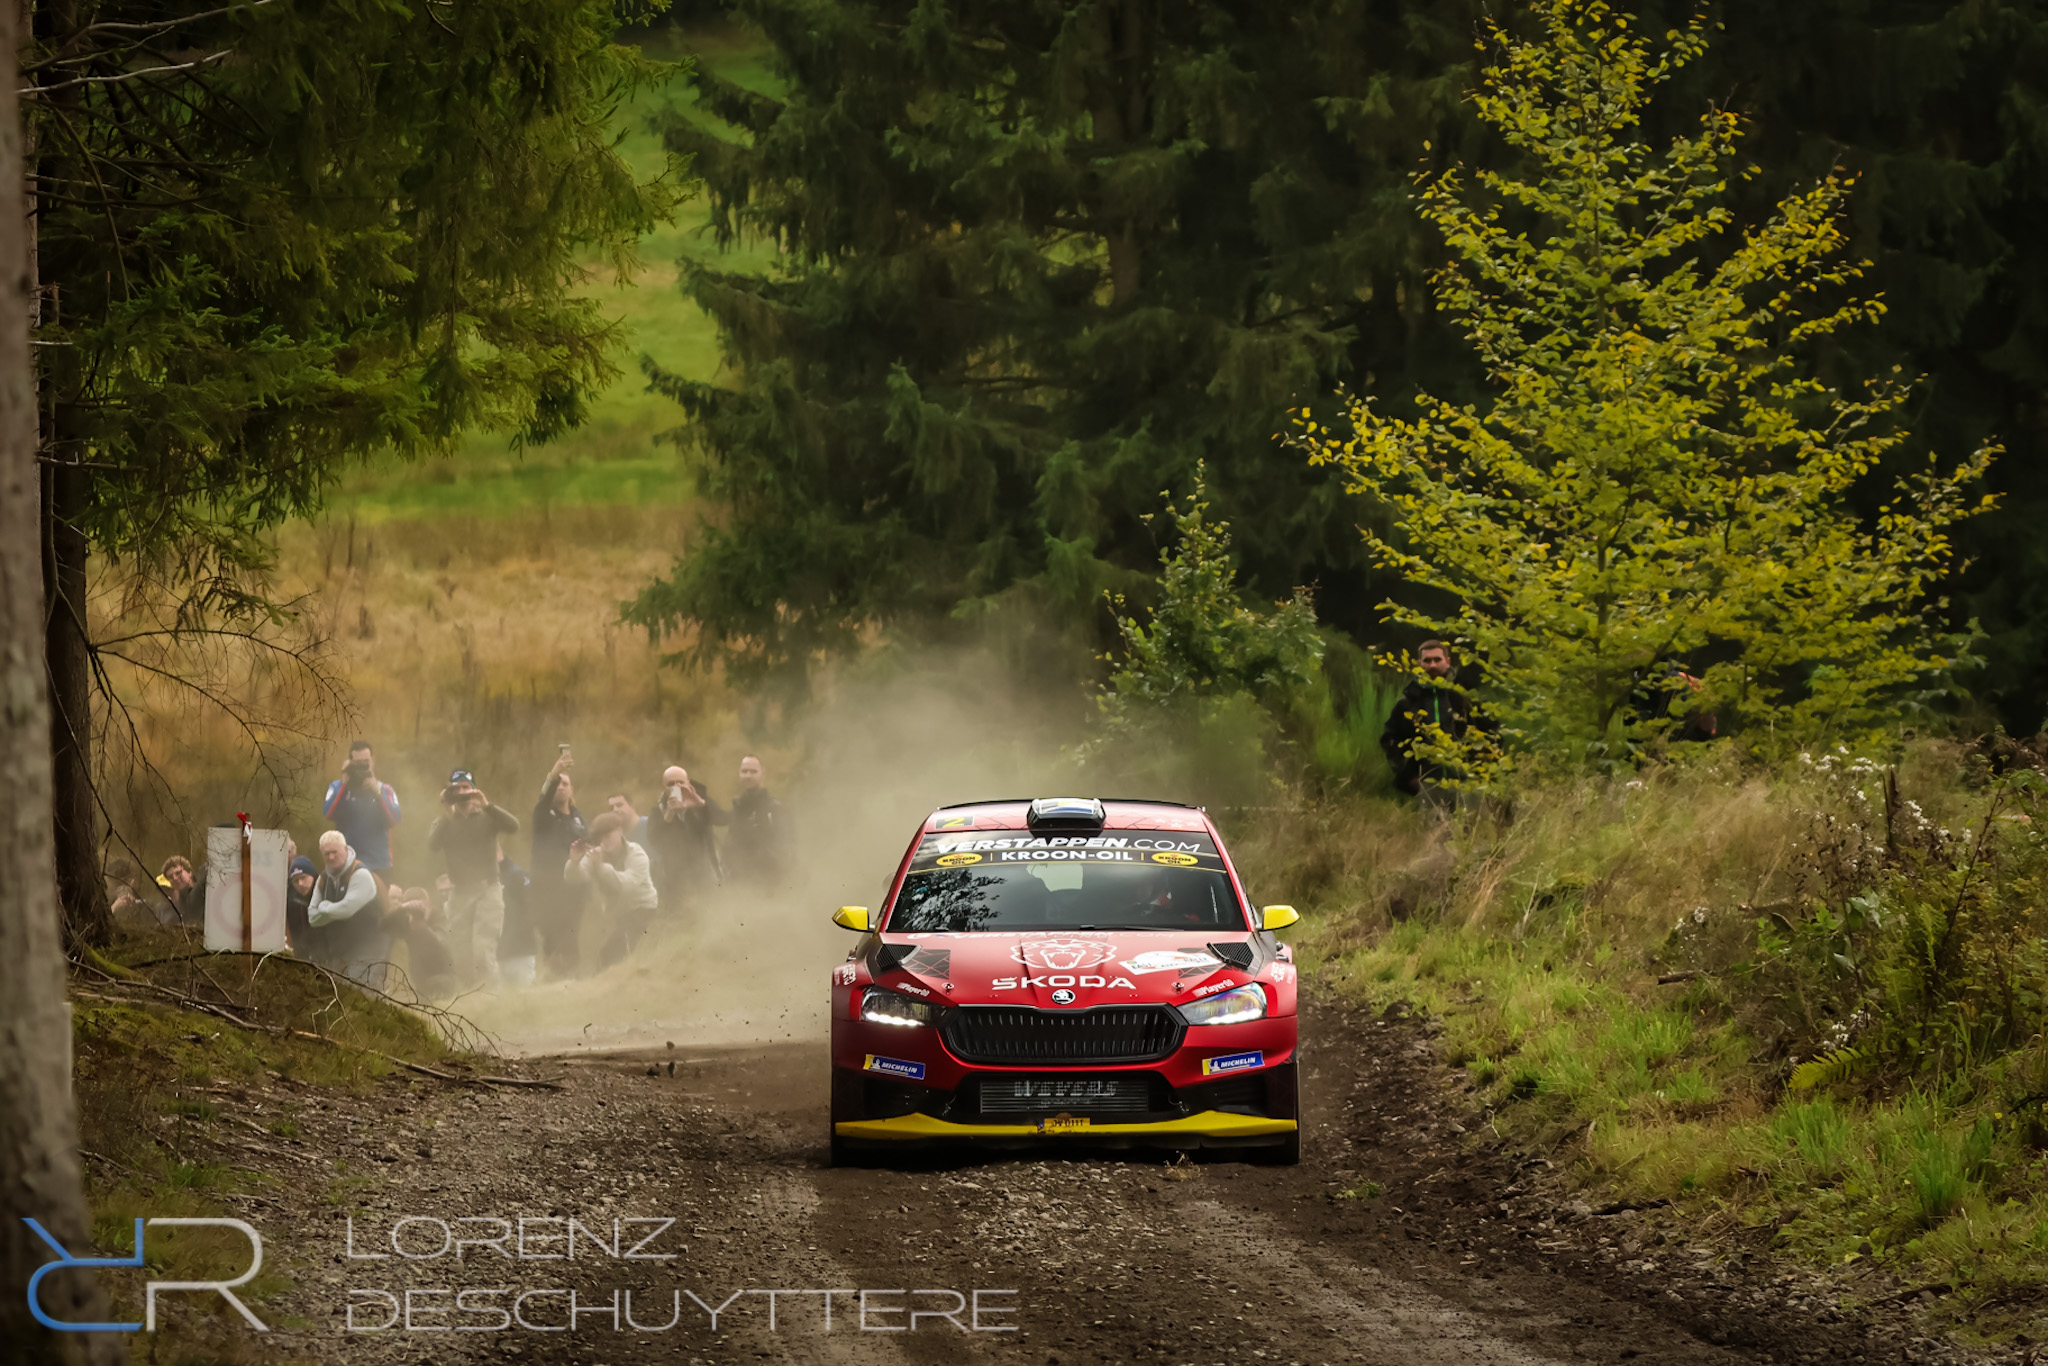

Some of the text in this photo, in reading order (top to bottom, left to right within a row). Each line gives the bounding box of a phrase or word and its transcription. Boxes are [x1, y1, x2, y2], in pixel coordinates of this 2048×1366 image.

[937, 837, 1200, 853] VERSTAPPEN.COM
[1001, 850, 1133, 861] KROON-OIL
[881, 1062, 918, 1073] MICHELIN
[1220, 1057, 1256, 1068] MICHELIN
